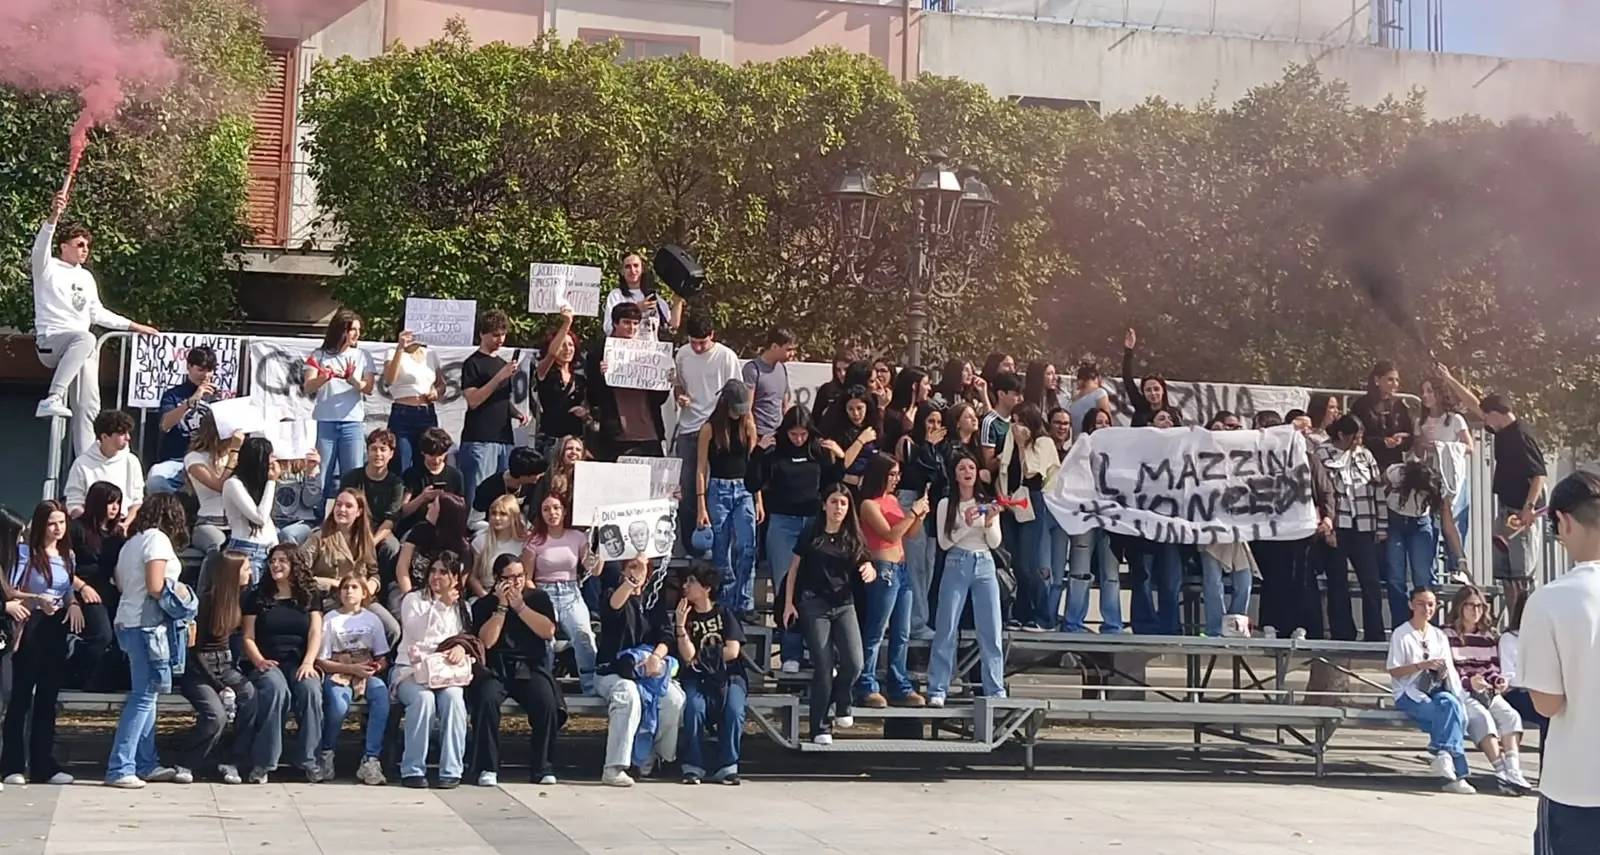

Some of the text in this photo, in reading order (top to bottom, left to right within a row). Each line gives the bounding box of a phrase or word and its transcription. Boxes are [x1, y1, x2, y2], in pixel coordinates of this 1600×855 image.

[138, 334, 177, 348] NON
[136, 347, 167, 361] DATO
[221, 350, 237, 364] LA
[629, 351, 661, 366] LUSSO
[139, 360, 180, 373] SIAMO
[135, 372, 146, 385] IL
[211, 377, 232, 391] ON
[134, 385, 168, 401] REST
